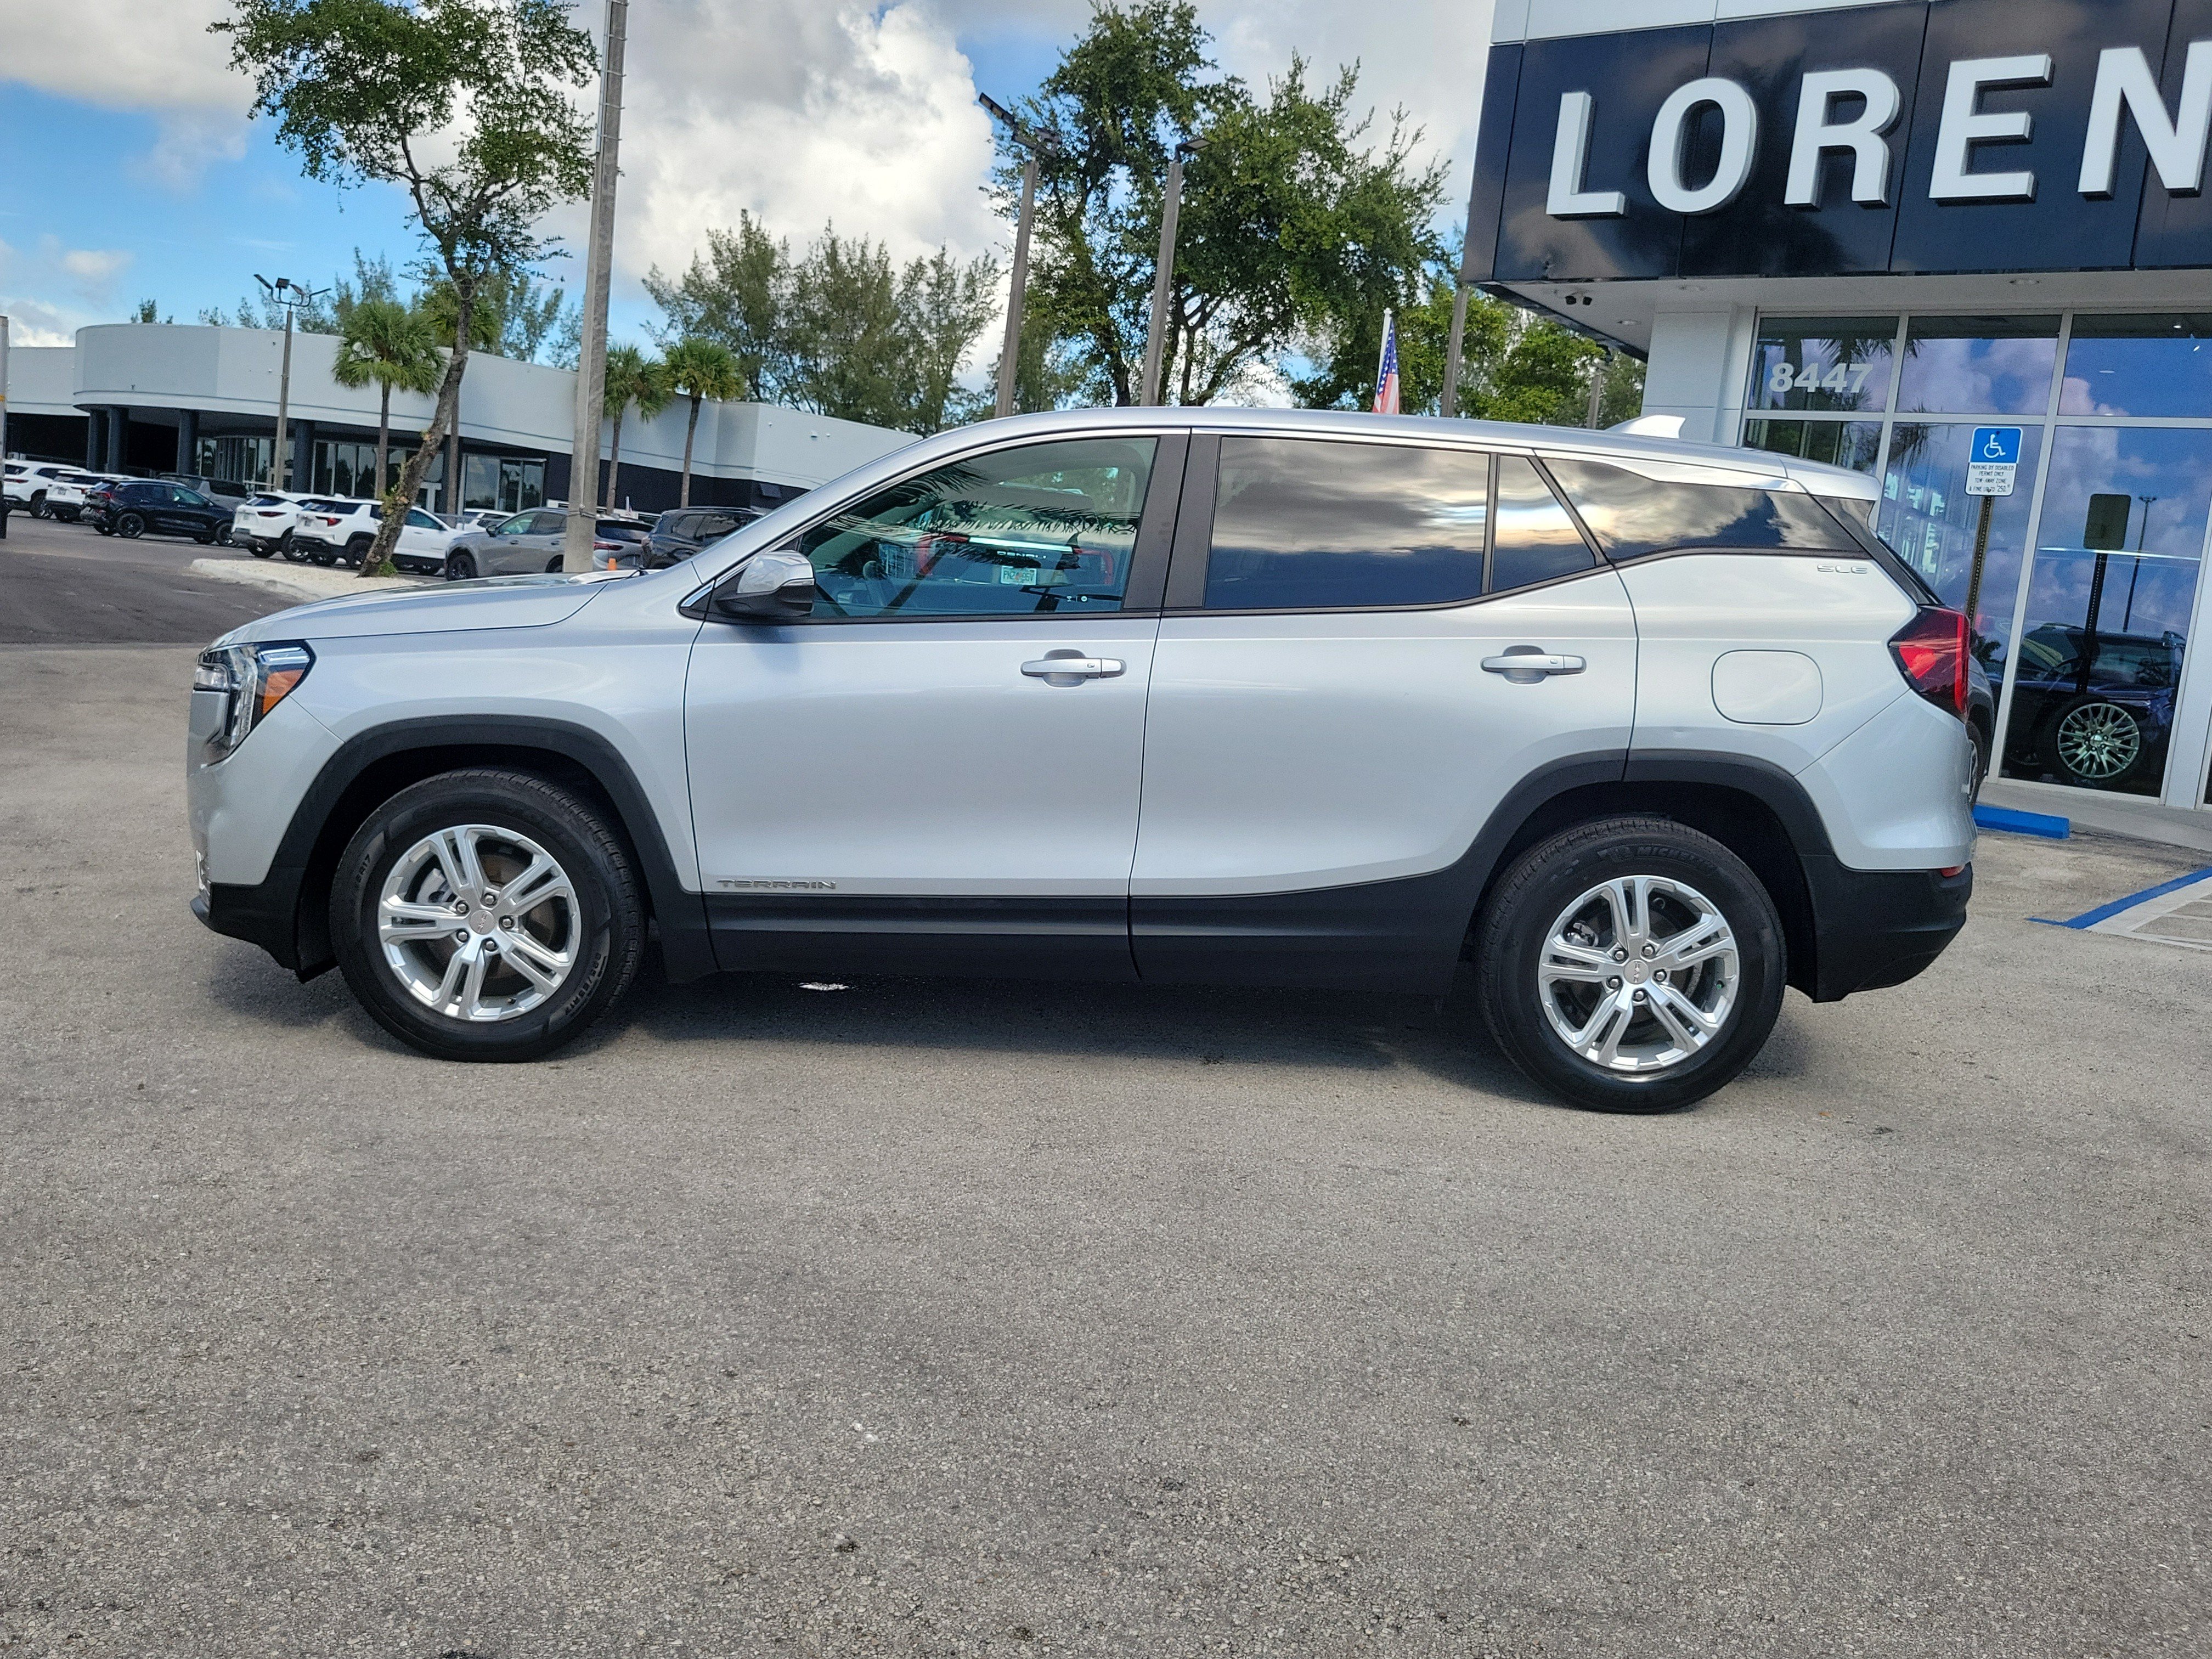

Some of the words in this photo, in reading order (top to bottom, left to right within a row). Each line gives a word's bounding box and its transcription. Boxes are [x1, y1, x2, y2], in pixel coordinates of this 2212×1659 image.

[1545, 40, 2212, 216] LOREN
[1769, 362, 1874, 393] 8447
[1817, 565, 1867, 574] SLE
[716, 879, 836, 889] TERRAIN
